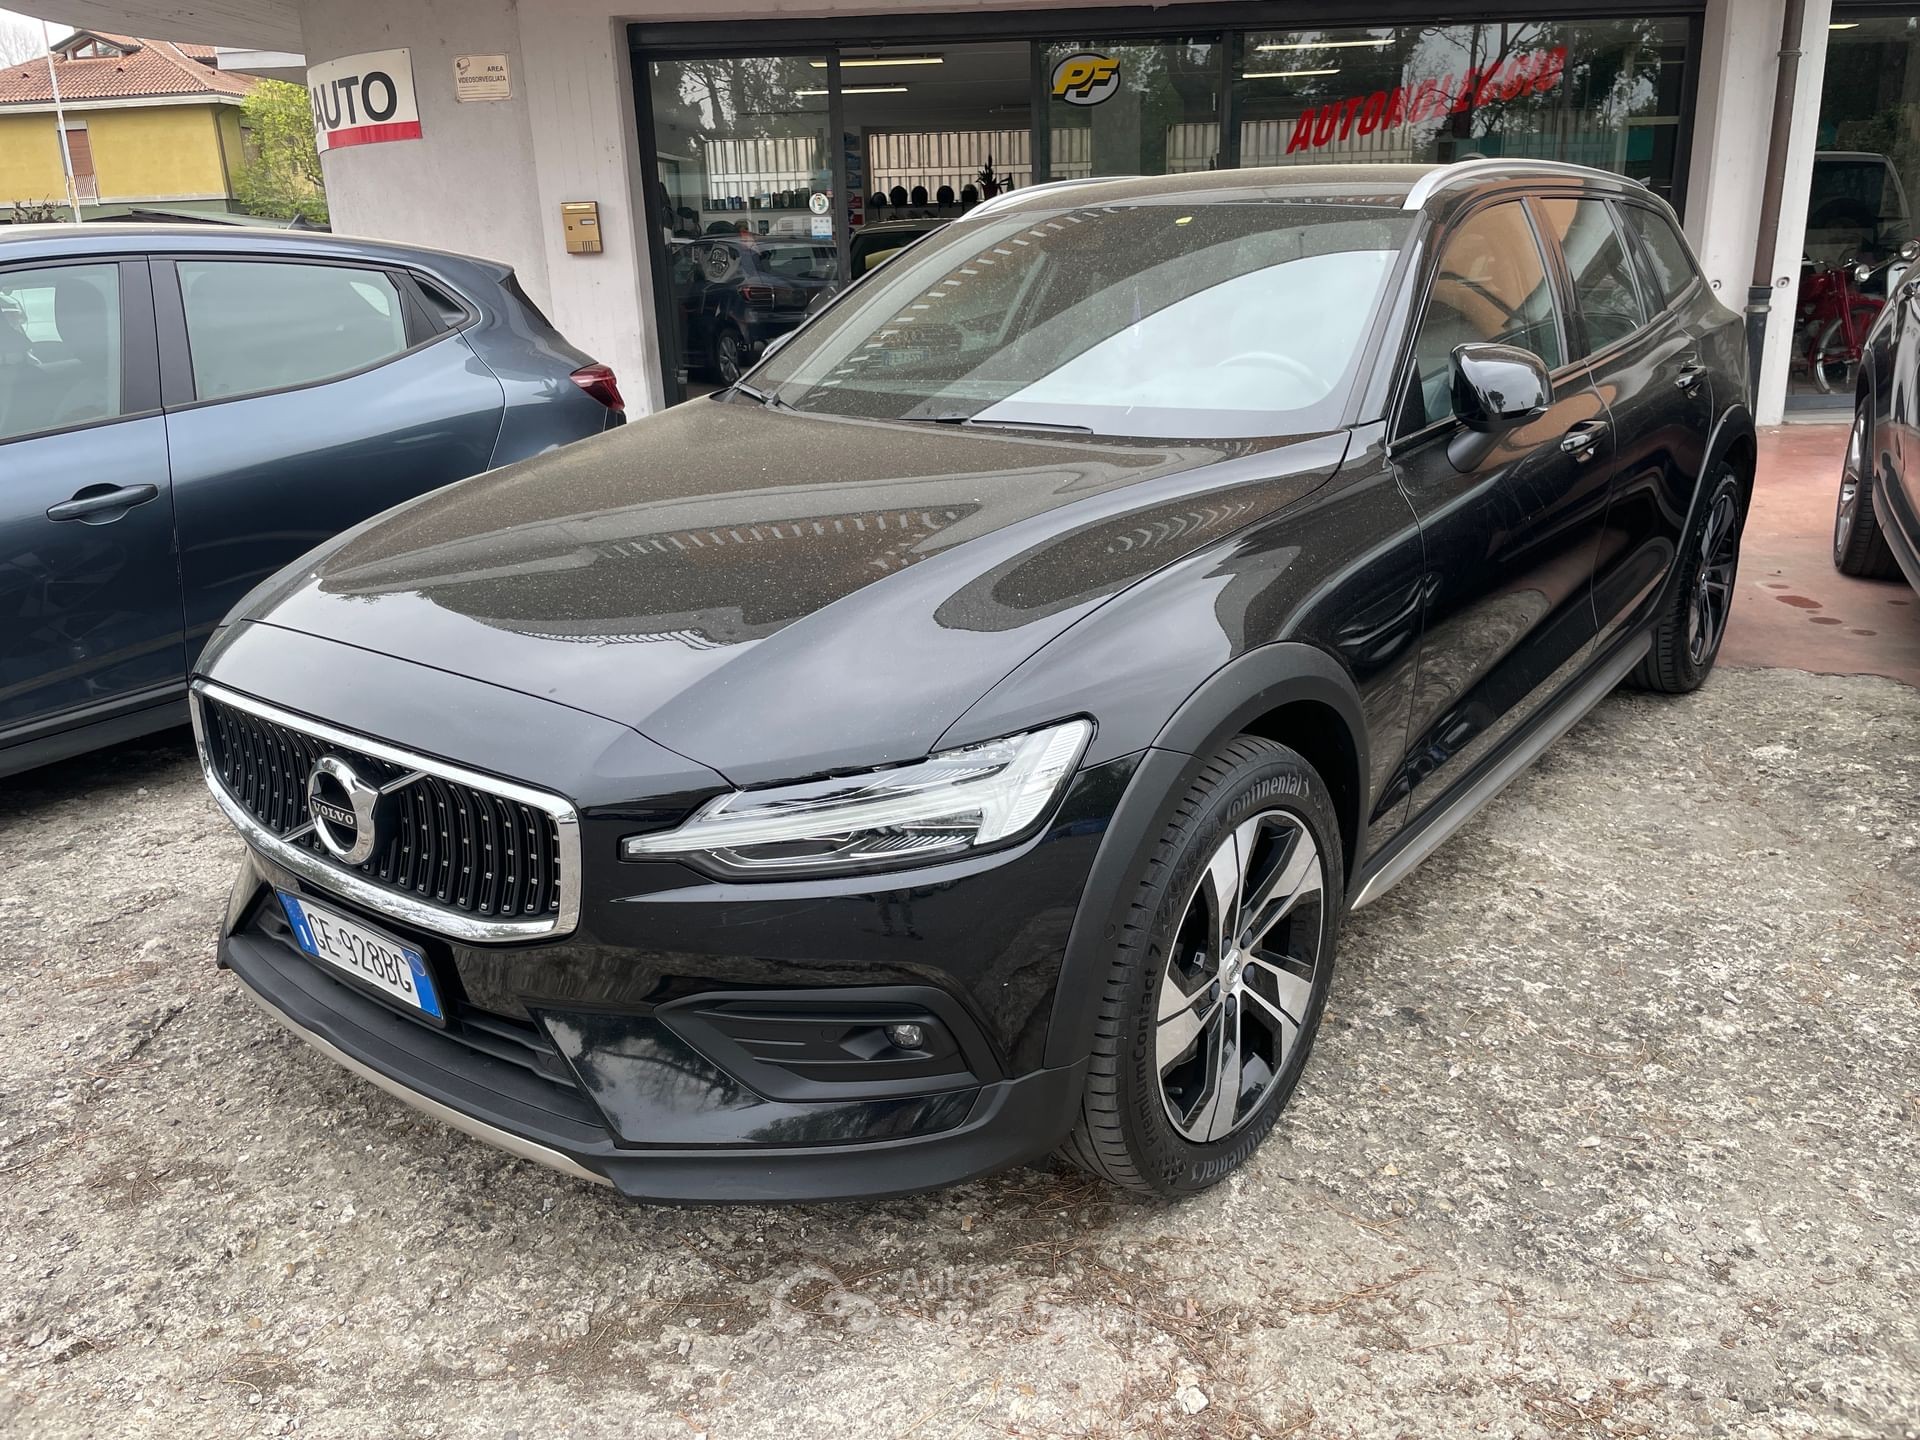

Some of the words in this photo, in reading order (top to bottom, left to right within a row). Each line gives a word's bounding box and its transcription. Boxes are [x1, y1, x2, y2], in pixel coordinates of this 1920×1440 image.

[1052, 58, 1120, 97] PF
[312, 71, 397, 134] AUTO
[311, 800, 354, 825] VOLVO
[1226, 772, 1303, 820] Continental
